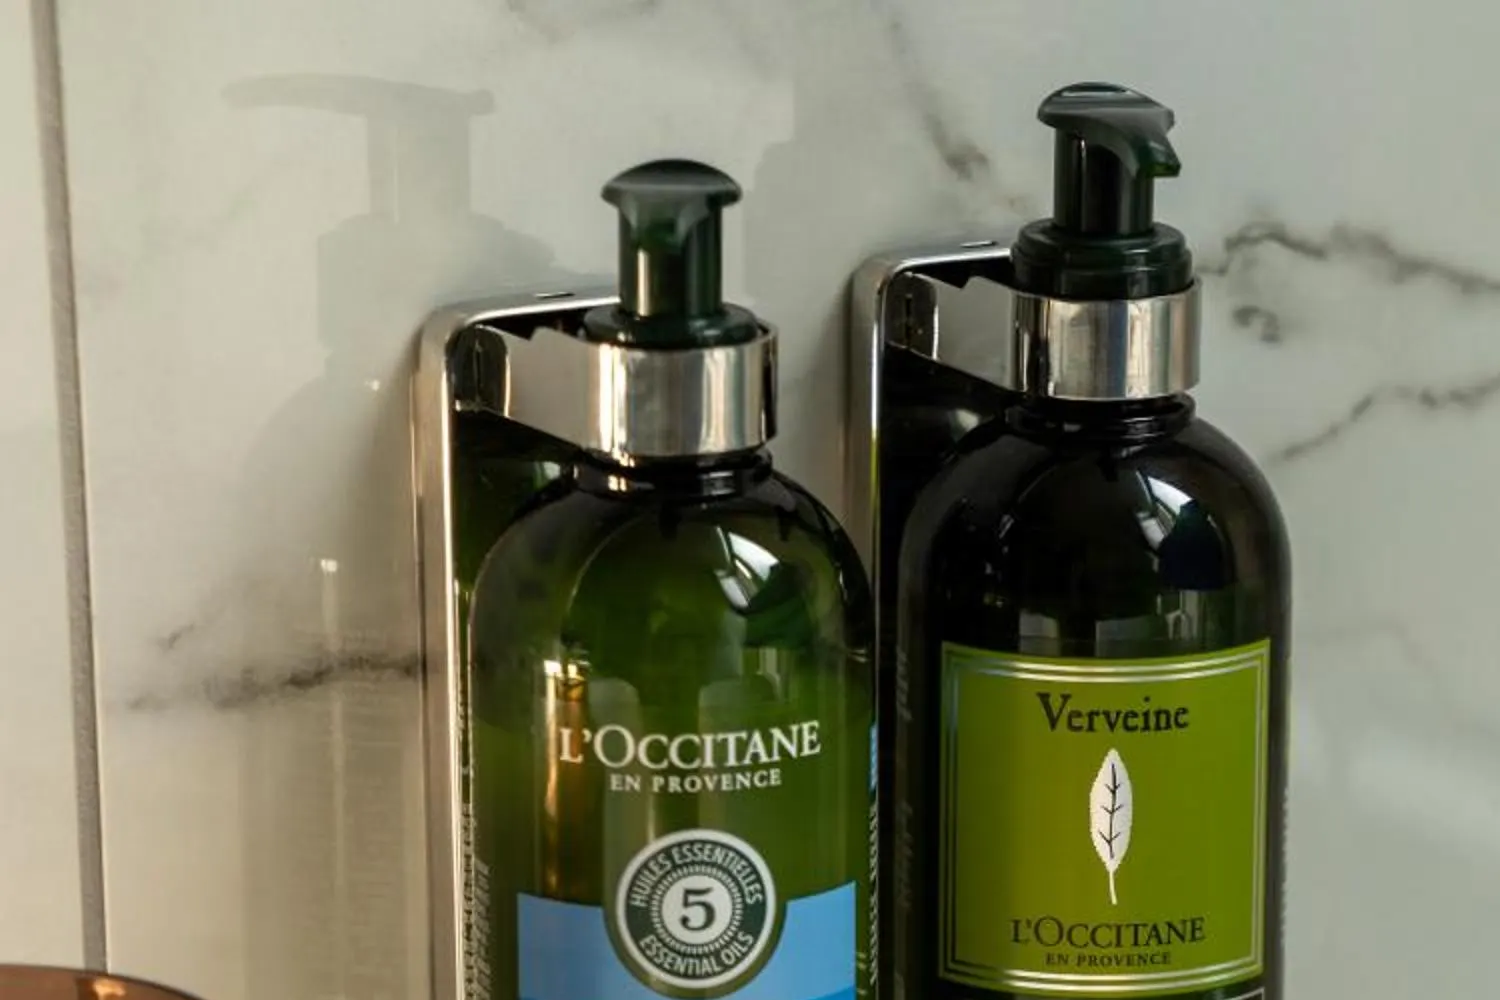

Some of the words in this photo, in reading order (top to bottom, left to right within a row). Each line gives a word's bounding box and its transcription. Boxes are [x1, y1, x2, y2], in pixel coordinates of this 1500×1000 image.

[1036, 692, 1190, 733] Verveine
[559, 720, 822, 769] L'OCCITANE
[610, 773, 641, 791] EN
[652, 768, 782, 793] PROVENCE
[629, 853, 673, 907] HUILES
[671, 843, 763, 905] ESSENTIELLES
[680, 886, 716, 931] 5
[1010, 915, 1206, 948] L'OCCITANE
[639, 934, 721, 976] ESSENTIAL
[721, 931, 754, 965] OILS
[1045, 952, 1070, 966] EN
[1076, 951, 1172, 968] PROVENCE
